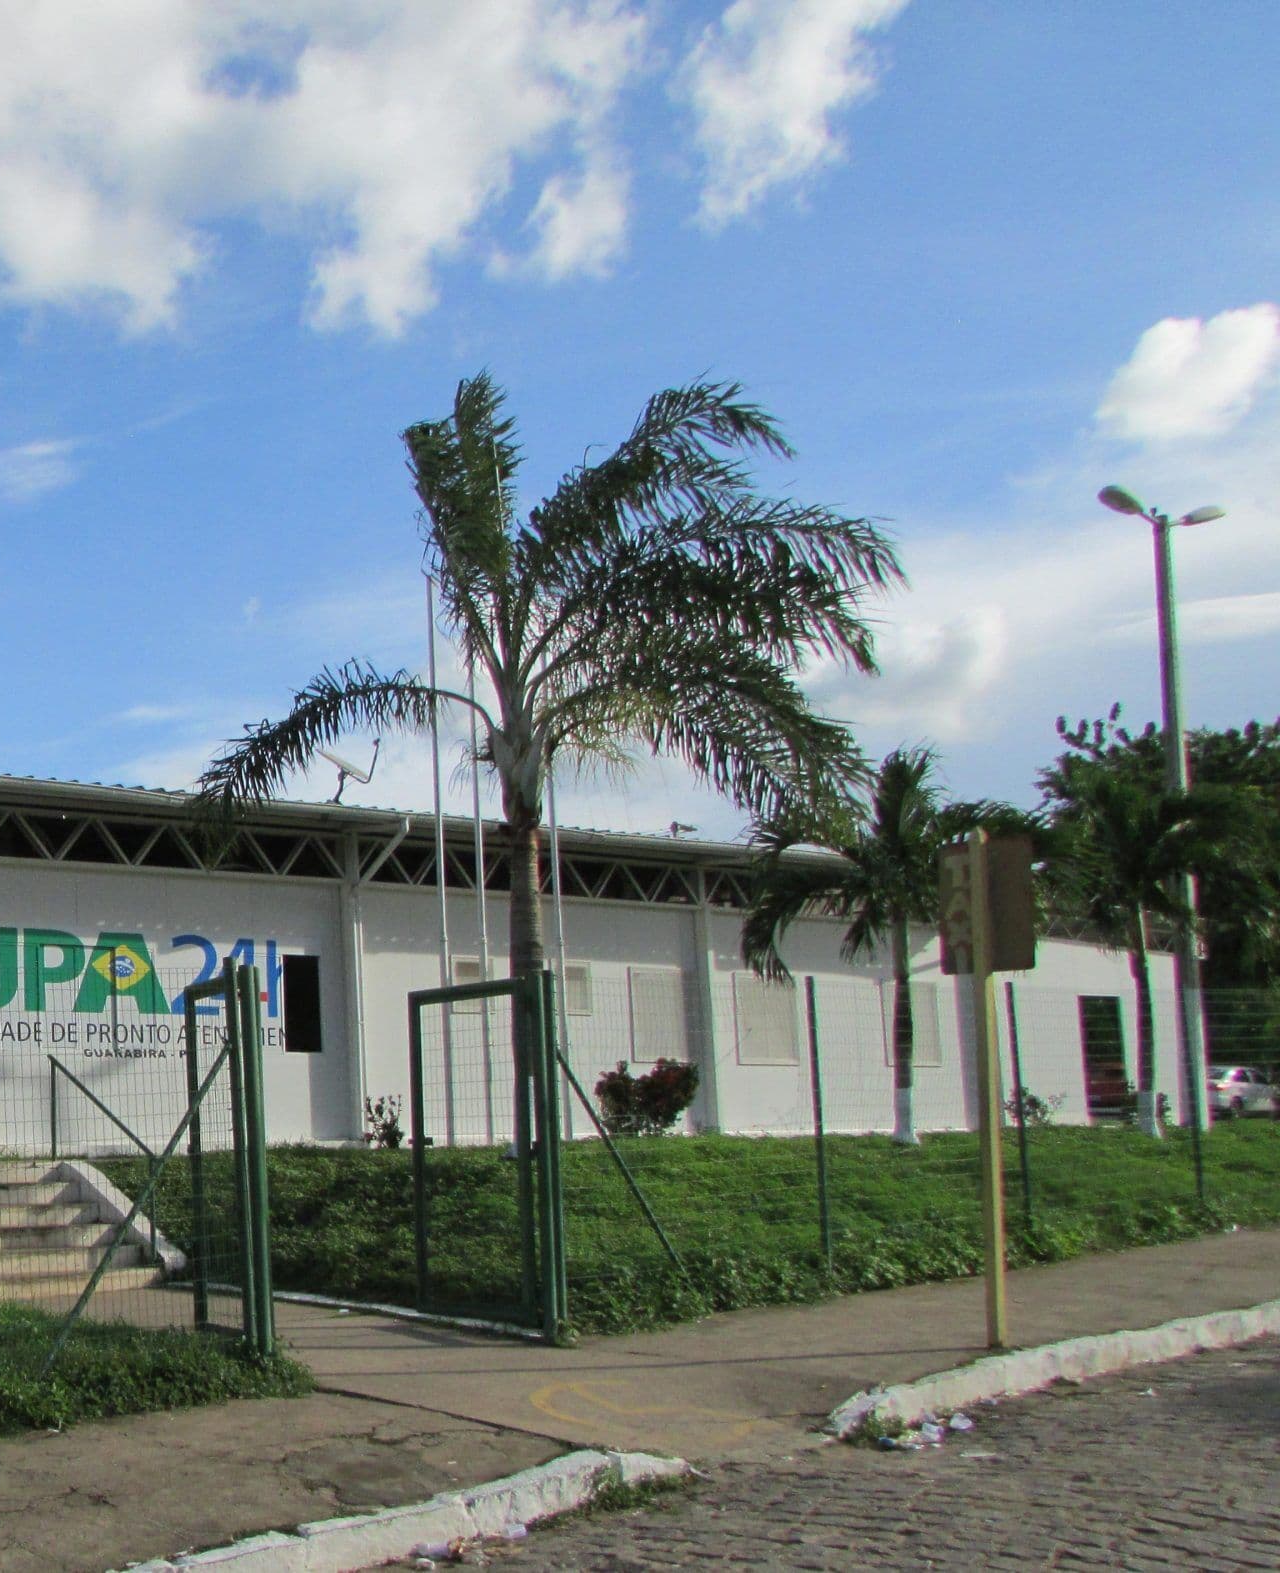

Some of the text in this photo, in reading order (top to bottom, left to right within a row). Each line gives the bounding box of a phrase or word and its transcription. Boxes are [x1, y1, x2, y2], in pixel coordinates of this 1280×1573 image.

[51, 1022, 77, 1043] DE
[86, 1023, 170, 1044] PRONTO
[84, 1048, 166, 1059] GUARABIRA
